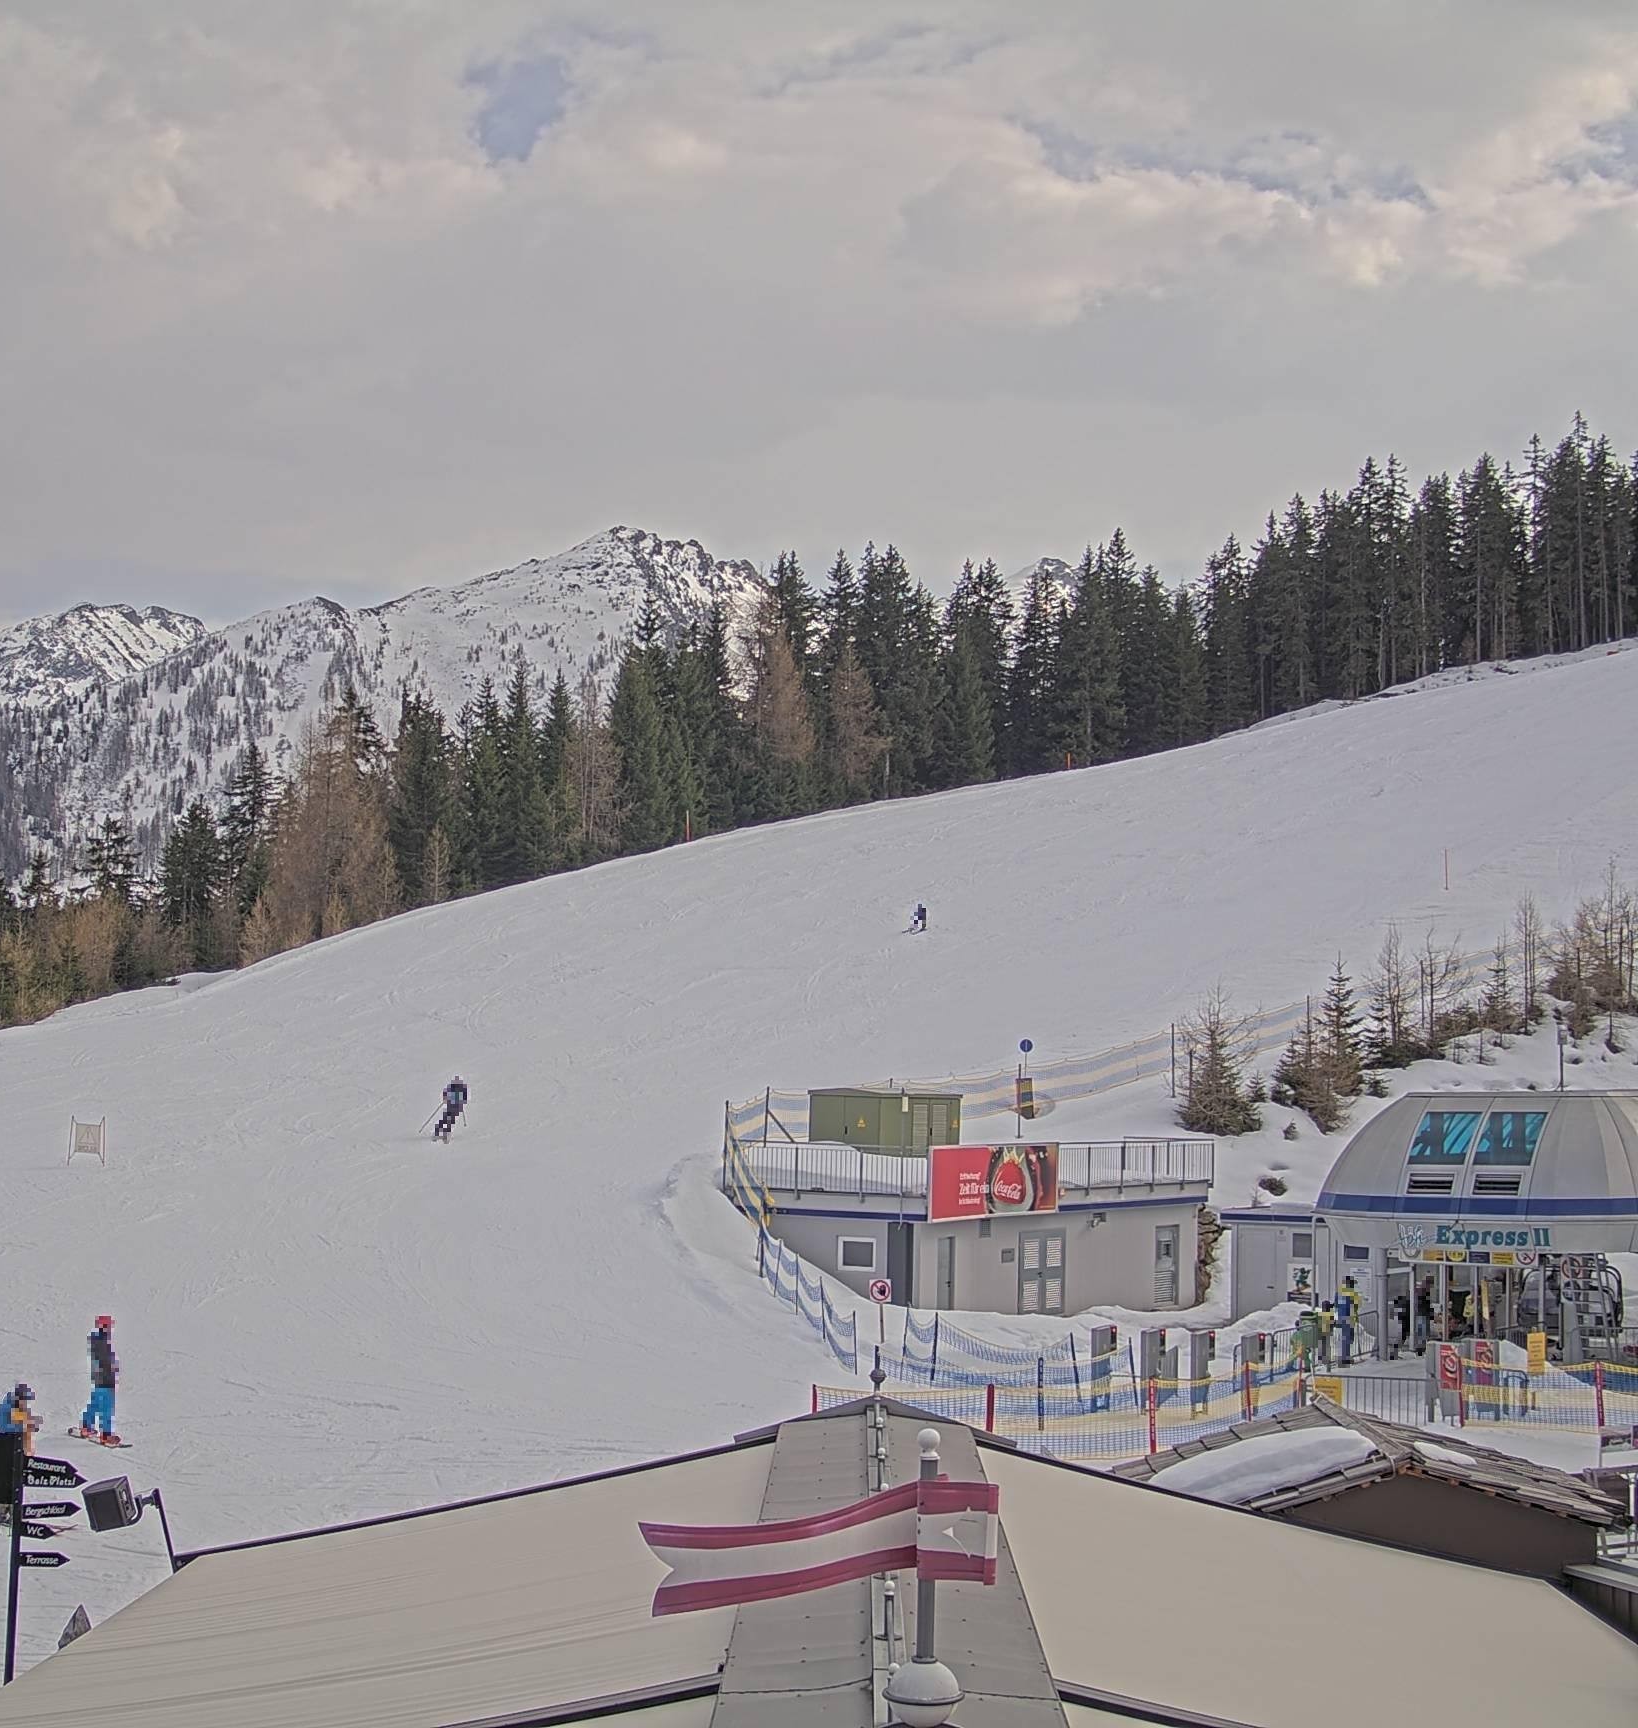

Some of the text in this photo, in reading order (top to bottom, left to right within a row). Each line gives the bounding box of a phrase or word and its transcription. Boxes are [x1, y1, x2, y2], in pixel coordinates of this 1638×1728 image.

[1435, 1225, 1529, 1249] Express
[27, 1458, 67, 1474] Restaurant
[26, 1524, 45, 1537] WC
[25, 1554, 59, 1565] Terrasse
